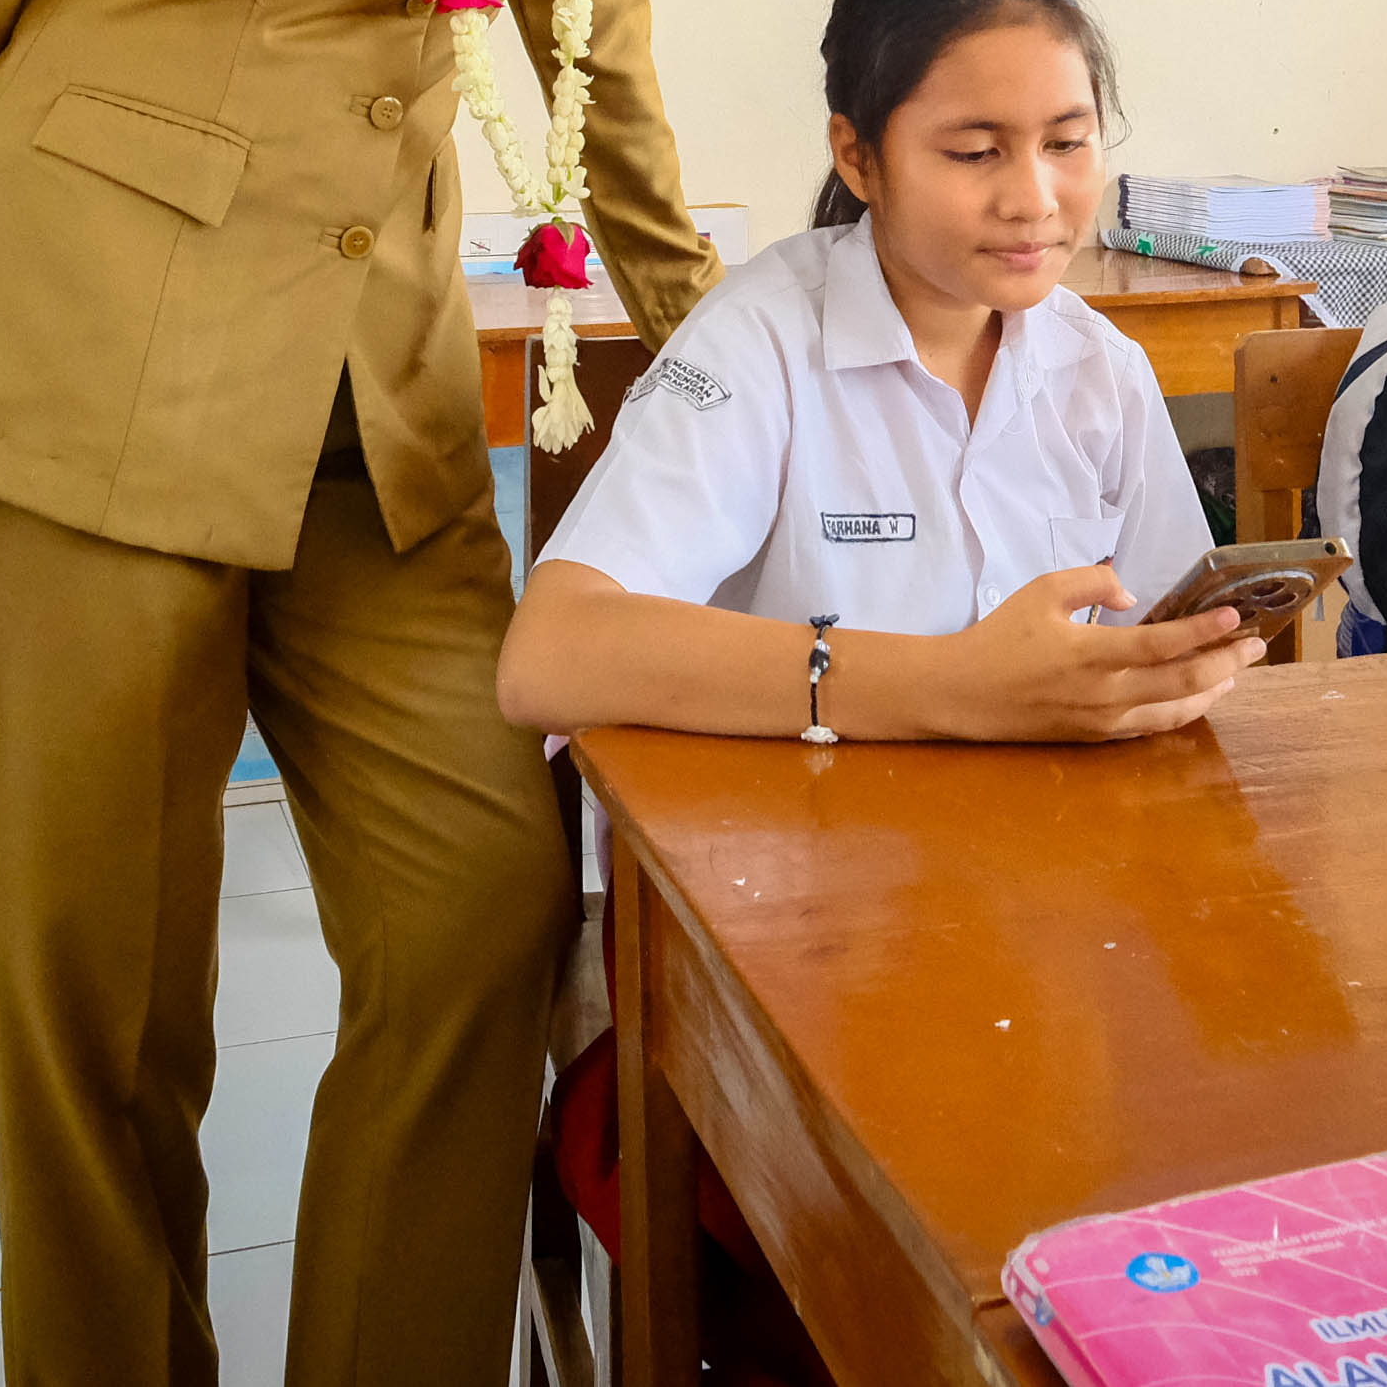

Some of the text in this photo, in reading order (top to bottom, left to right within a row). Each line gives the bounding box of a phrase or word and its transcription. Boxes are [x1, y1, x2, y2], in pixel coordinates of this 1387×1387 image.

[669, 368, 712, 398] RENGAN
[672, 360, 709, 384] MASAN
[889, 520, 899, 534] W
